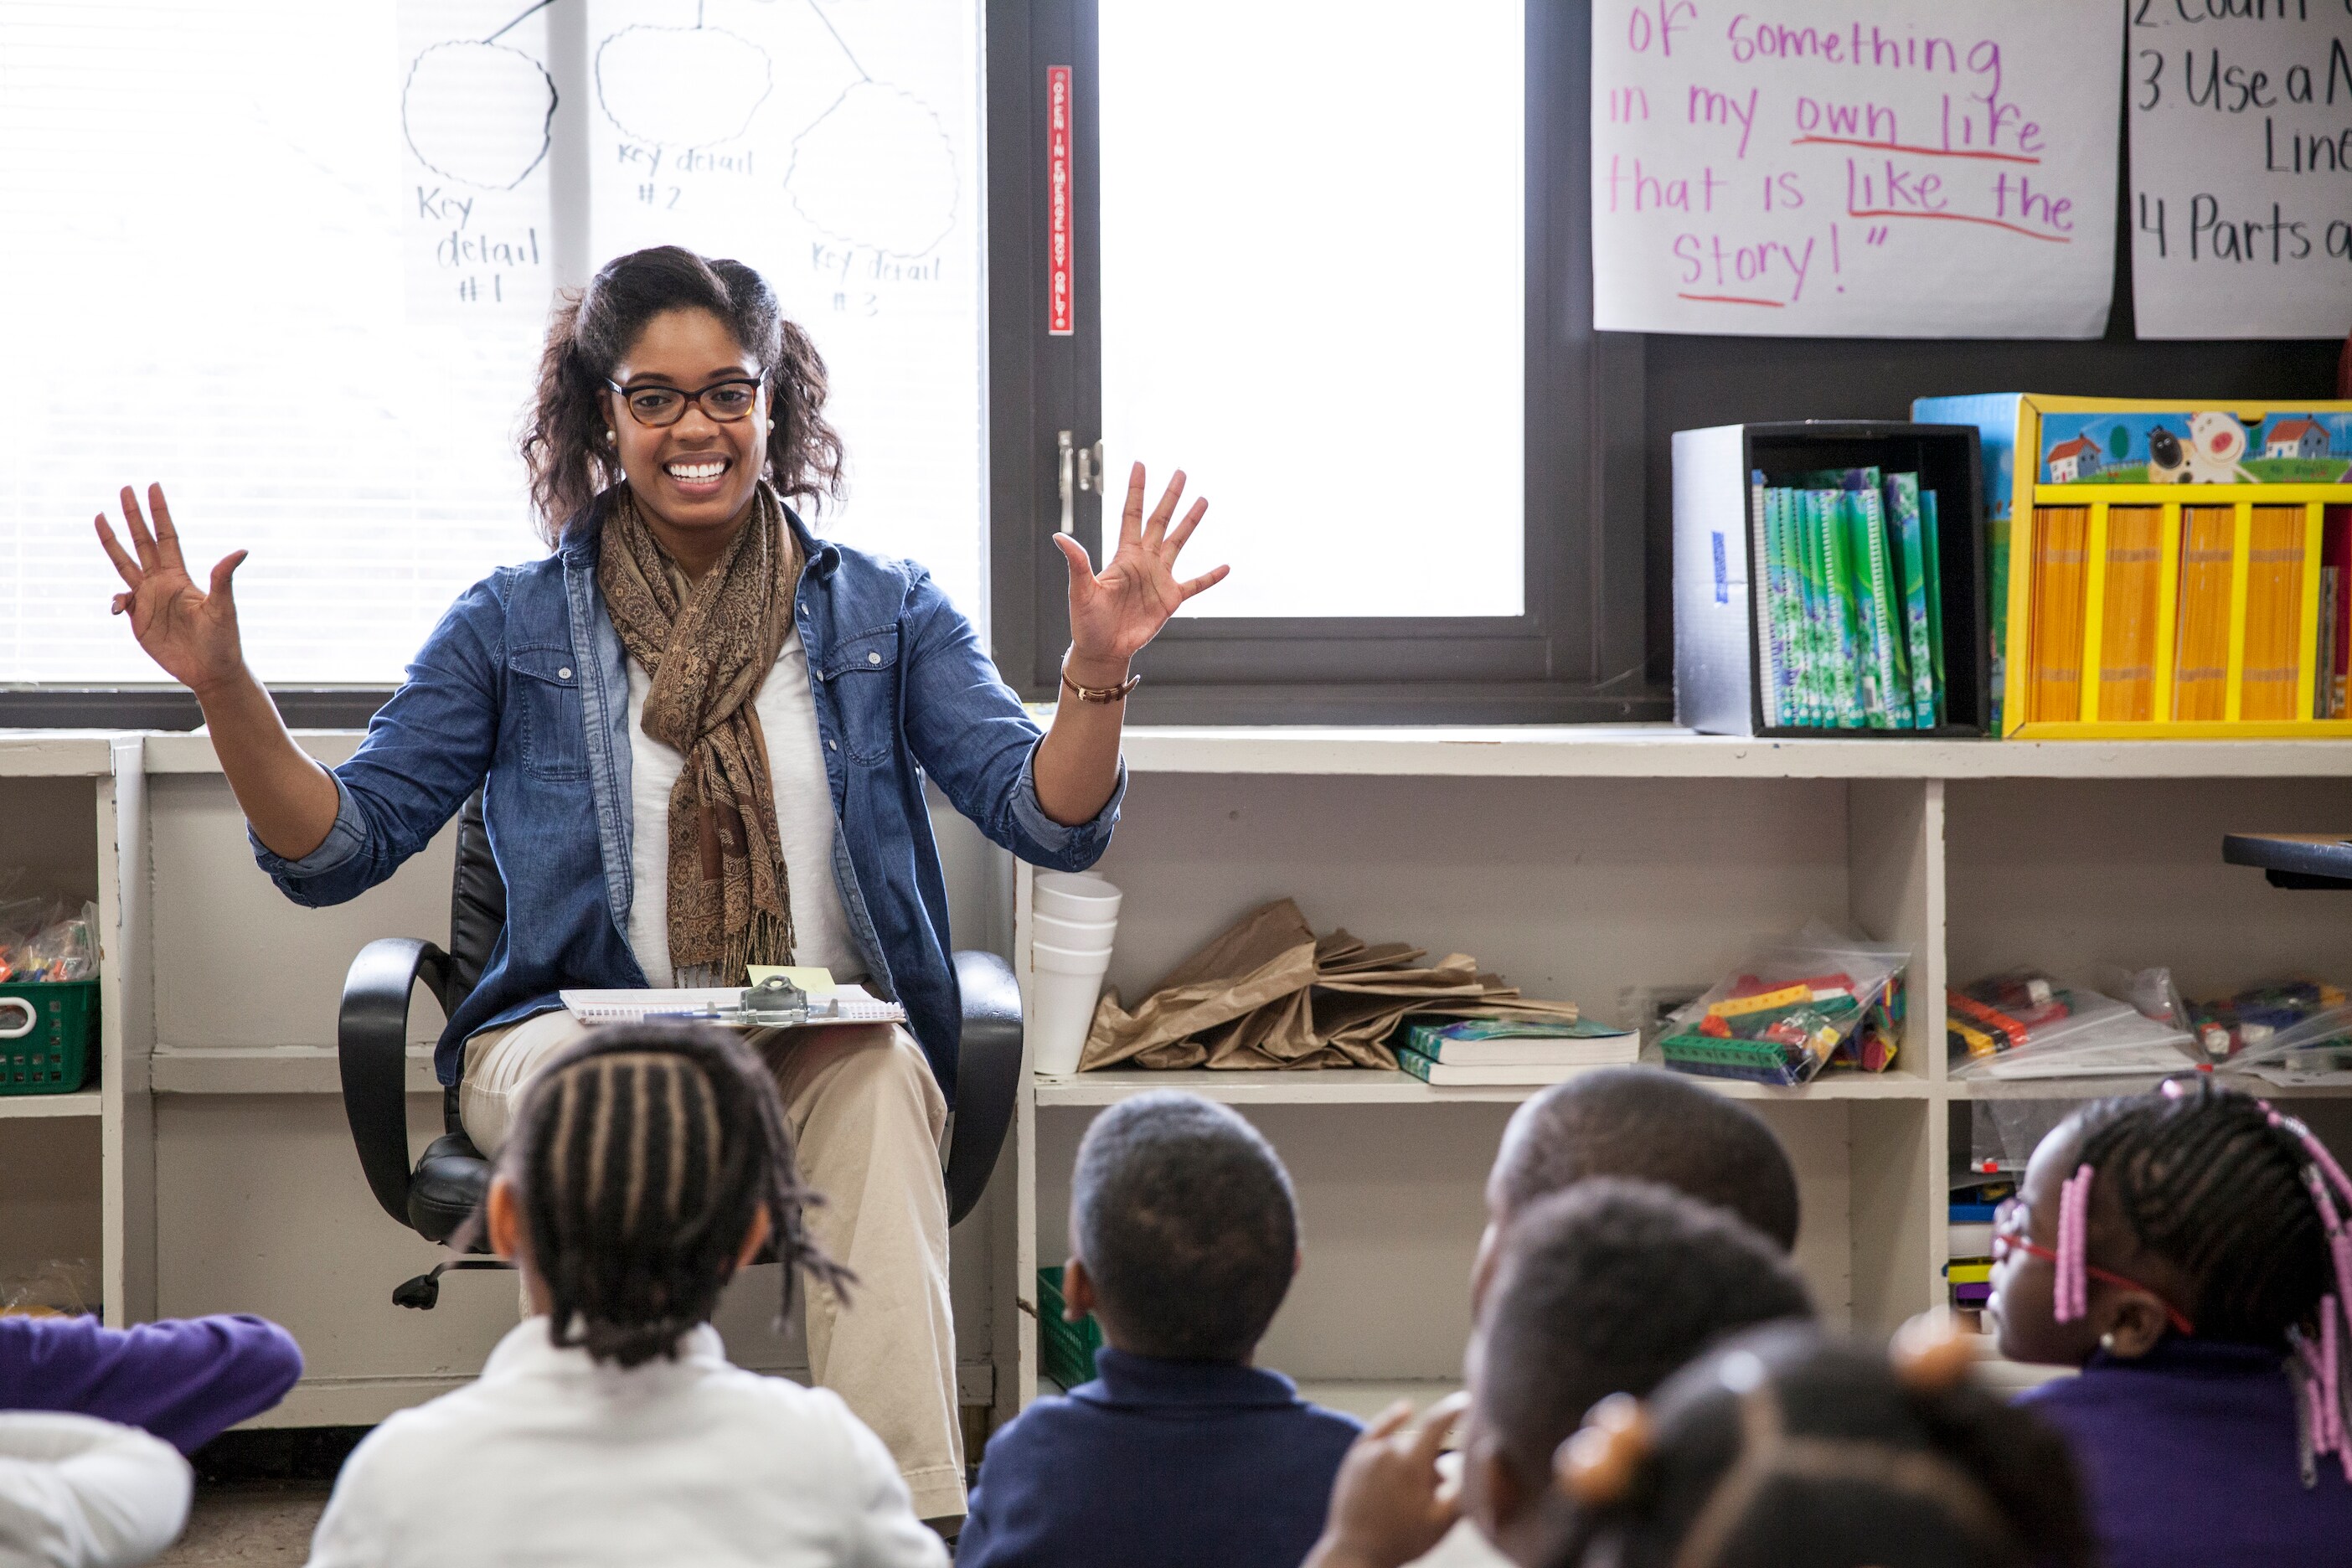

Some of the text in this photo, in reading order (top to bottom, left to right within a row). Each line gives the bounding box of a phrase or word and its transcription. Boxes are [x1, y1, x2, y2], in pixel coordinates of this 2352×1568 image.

[2185, 48, 2277, 114] Use
[2286, 64, 2313, 105] a
[1053, 81, 1065, 131] OPEN
[1609, 85, 2045, 160] in my own life
[676, 147, 754, 176] detail
[1054, 132, 1065, 157] IN
[415, 184, 475, 231] Key
[1608, 154, 1728, 213] that
[1764, 172, 1804, 212] is
[1990, 172, 2075, 232] the
[436, 227, 540, 271] detail
[2191, 193, 2312, 265] Parts
[812, 240, 941, 286] Key detail
